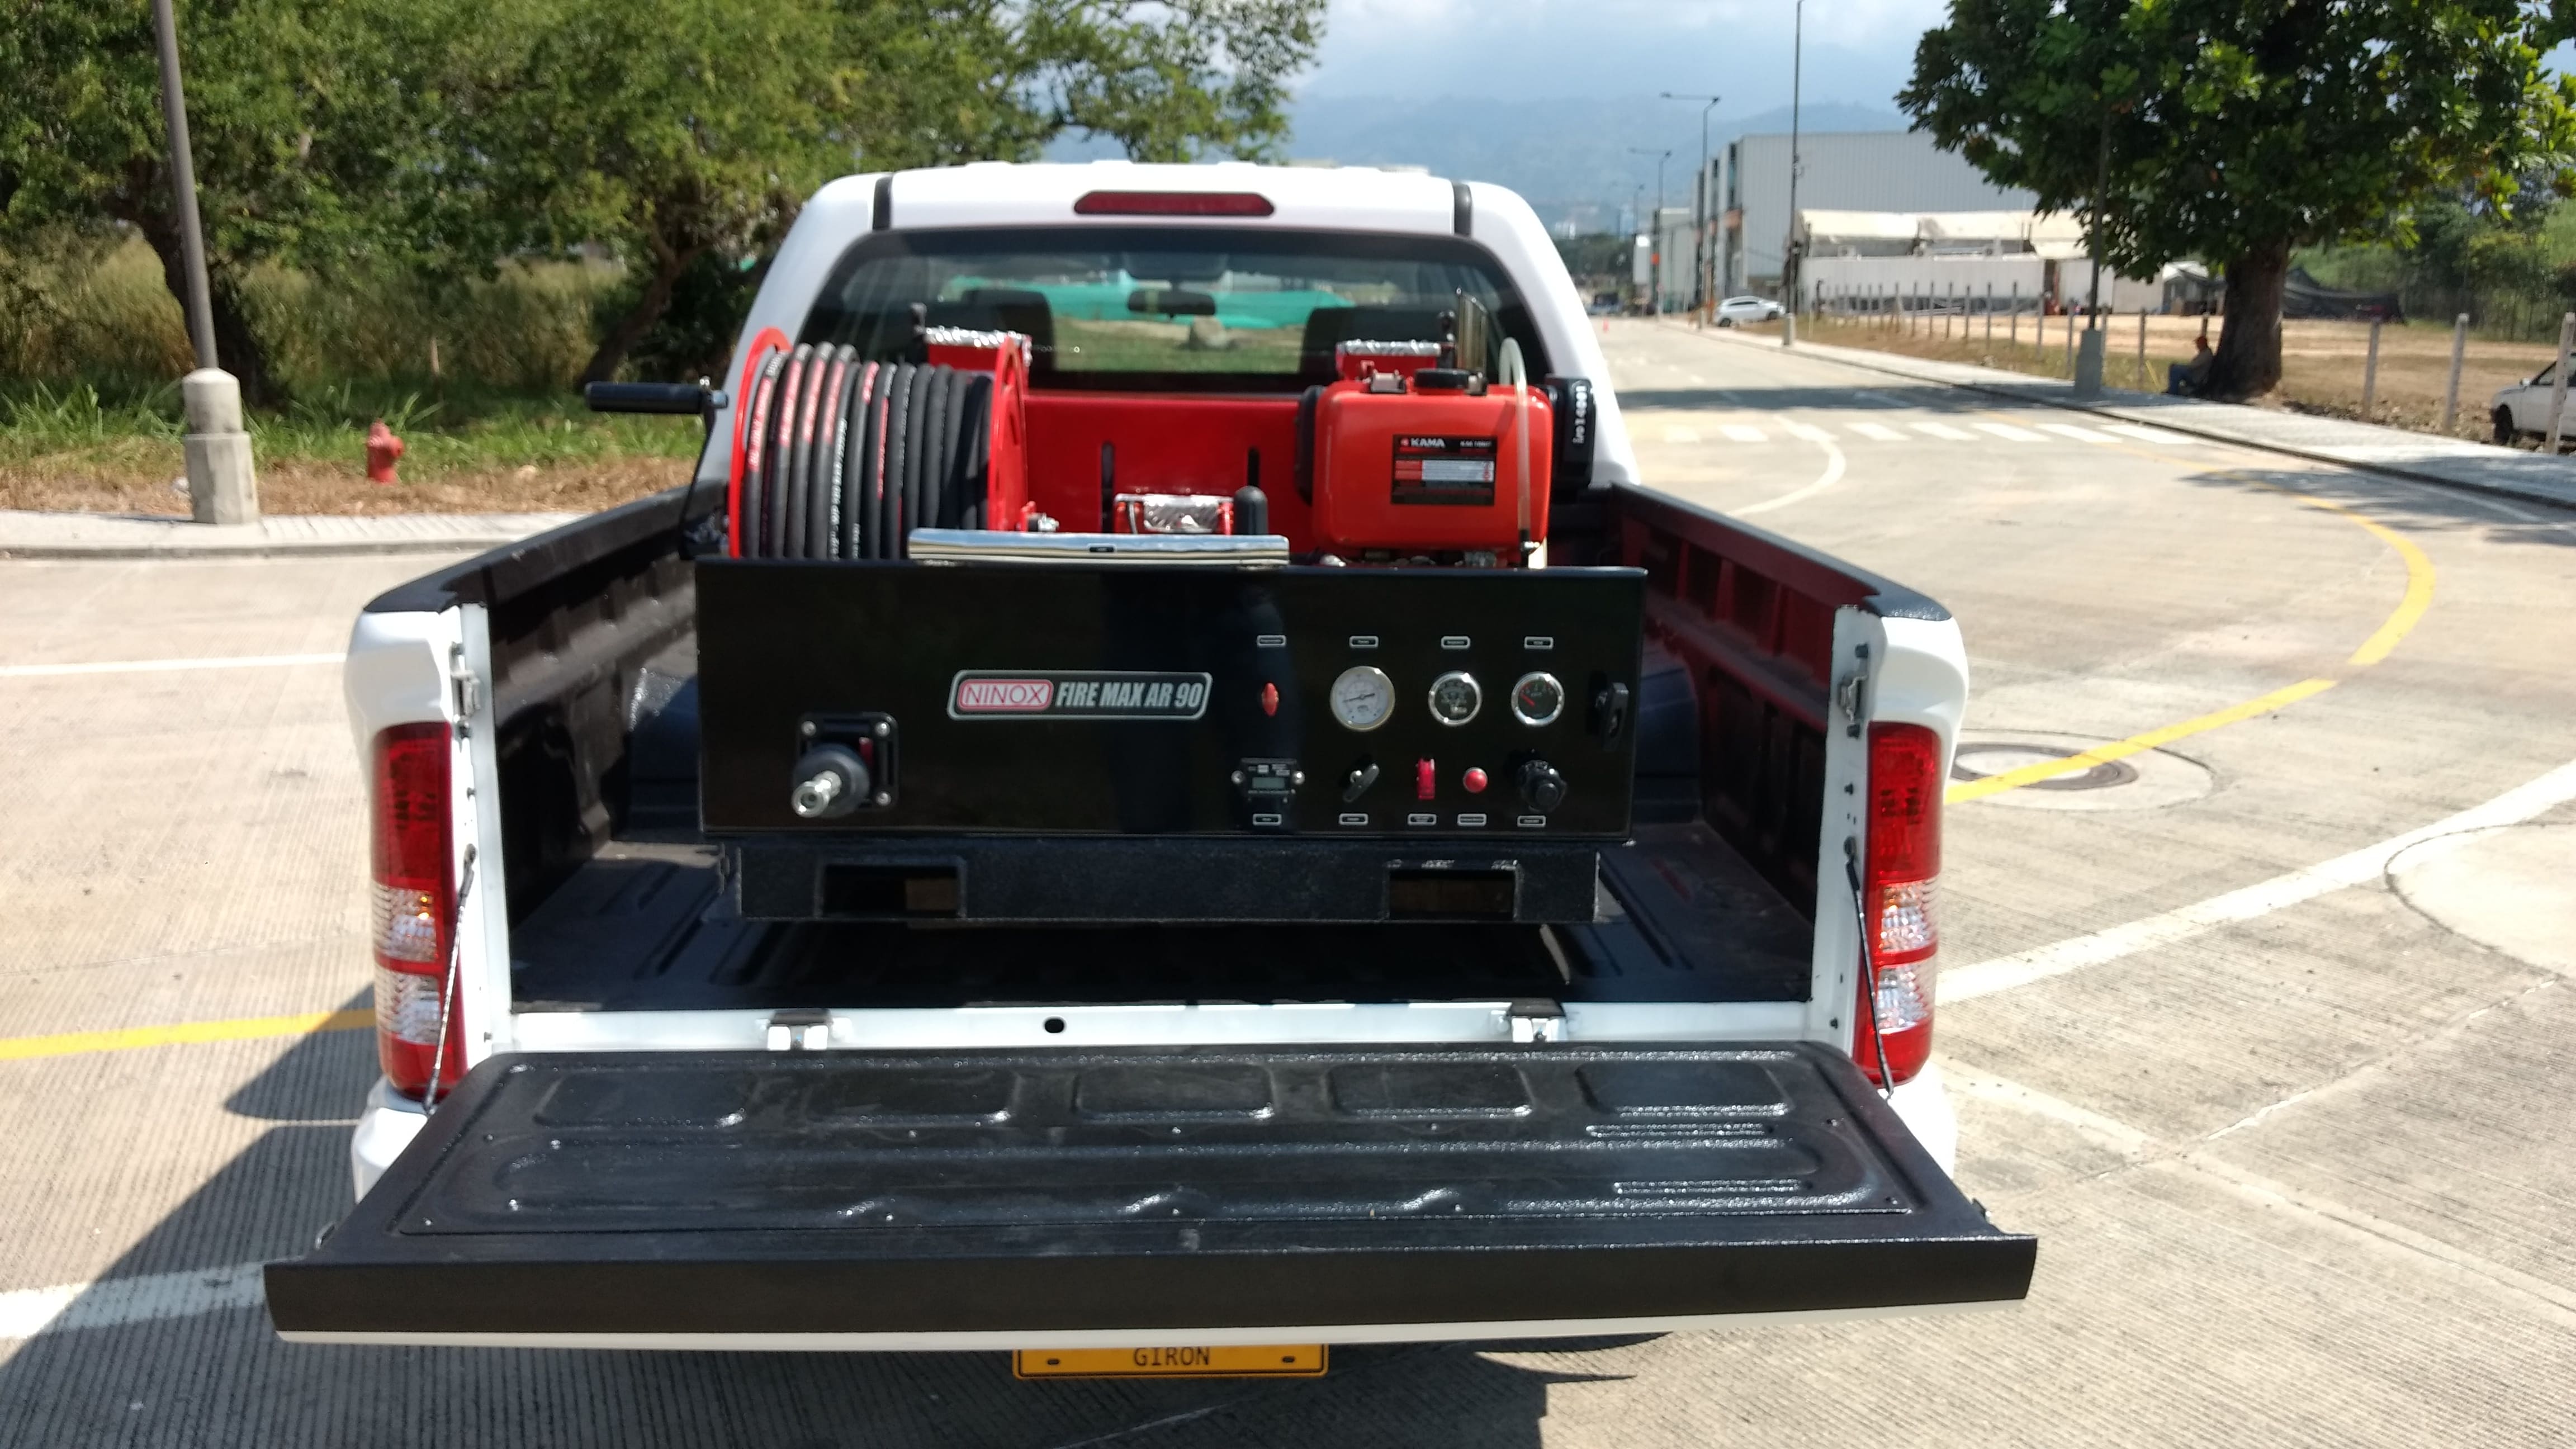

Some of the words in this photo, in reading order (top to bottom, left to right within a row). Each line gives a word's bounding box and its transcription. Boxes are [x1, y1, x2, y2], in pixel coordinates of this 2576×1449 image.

[1410, 438, 1445, 447] KAMA
[965, 684, 1045, 704] NINOX
[1055, 682, 1099, 707] FIRE
[1100, 682, 1145, 707] MAX
[1144, 683, 1174, 708] AR
[1174, 683, 1204, 708] 90
[1134, 1347, 1210, 1366] GIRON
